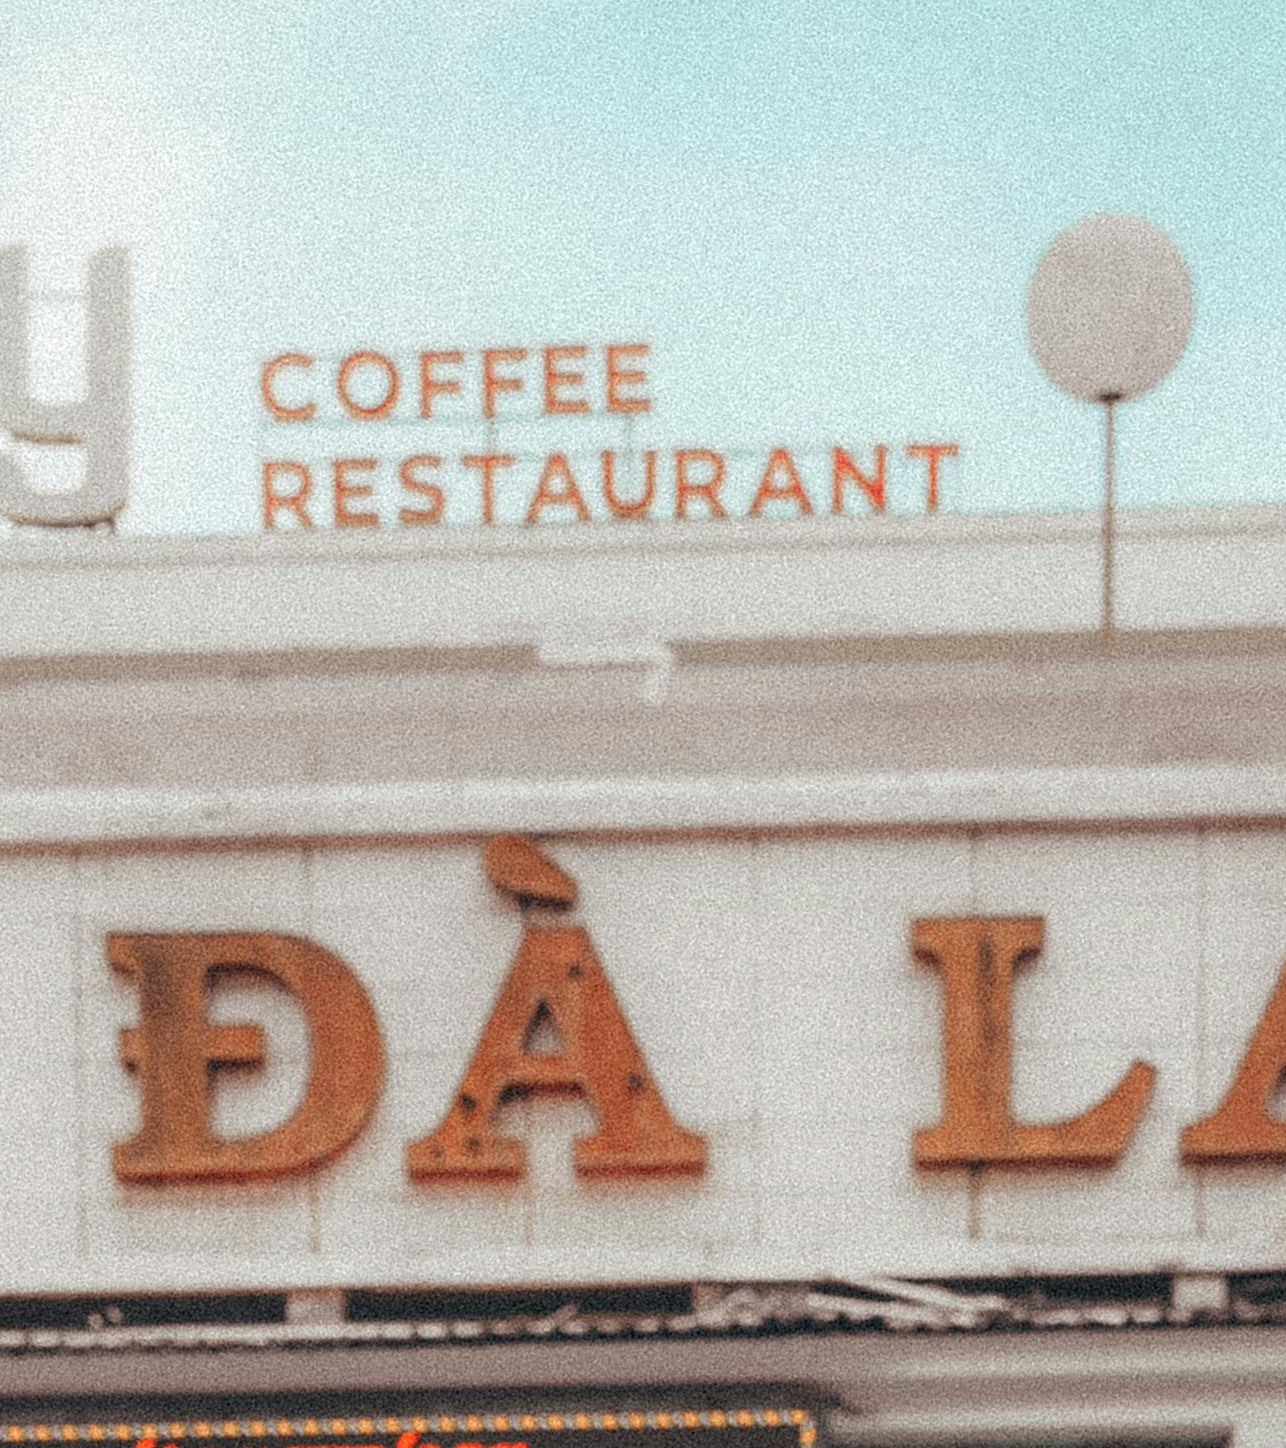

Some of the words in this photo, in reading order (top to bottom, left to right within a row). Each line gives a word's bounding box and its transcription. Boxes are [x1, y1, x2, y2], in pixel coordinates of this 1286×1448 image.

[260, 342, 652, 421] COFFEE
[260, 442, 961, 530] RESTAURANT
[105, 832, 709, 1184] ĐÀ
